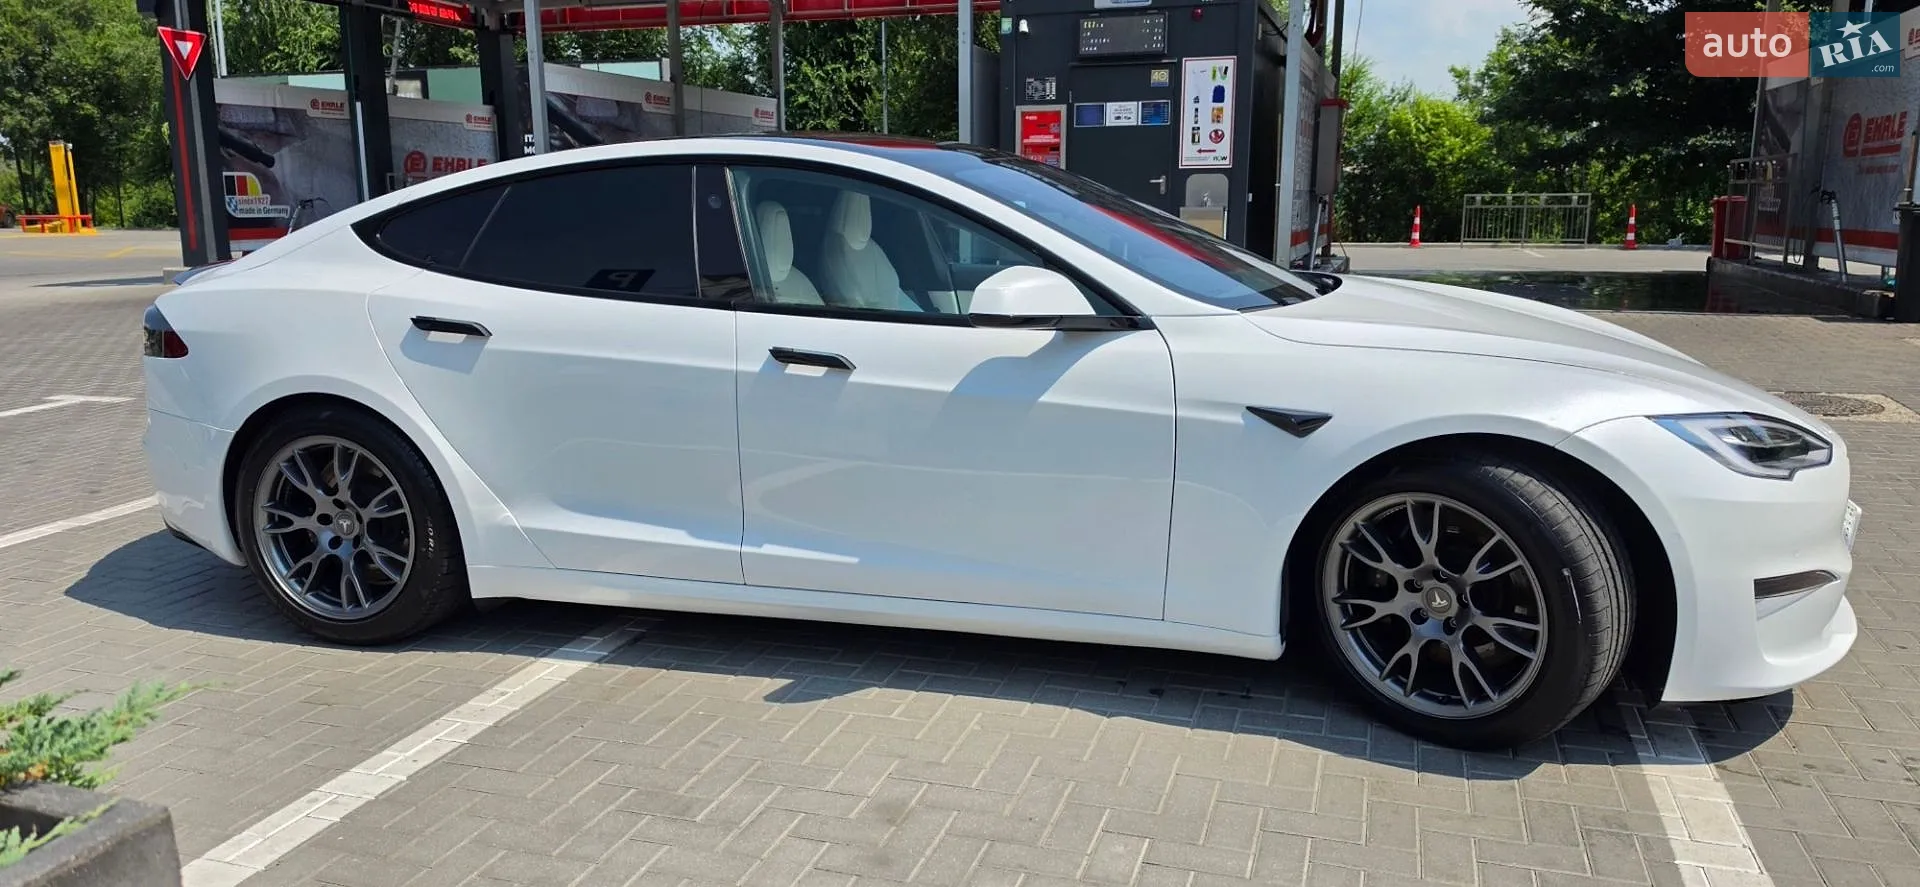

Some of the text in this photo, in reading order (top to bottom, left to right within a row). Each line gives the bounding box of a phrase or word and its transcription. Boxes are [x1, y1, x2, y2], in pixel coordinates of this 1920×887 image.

[1864, 111, 1908, 143] EHRLE
[239, 206, 256, 214] made
[263, 206, 289, 217] Germany
